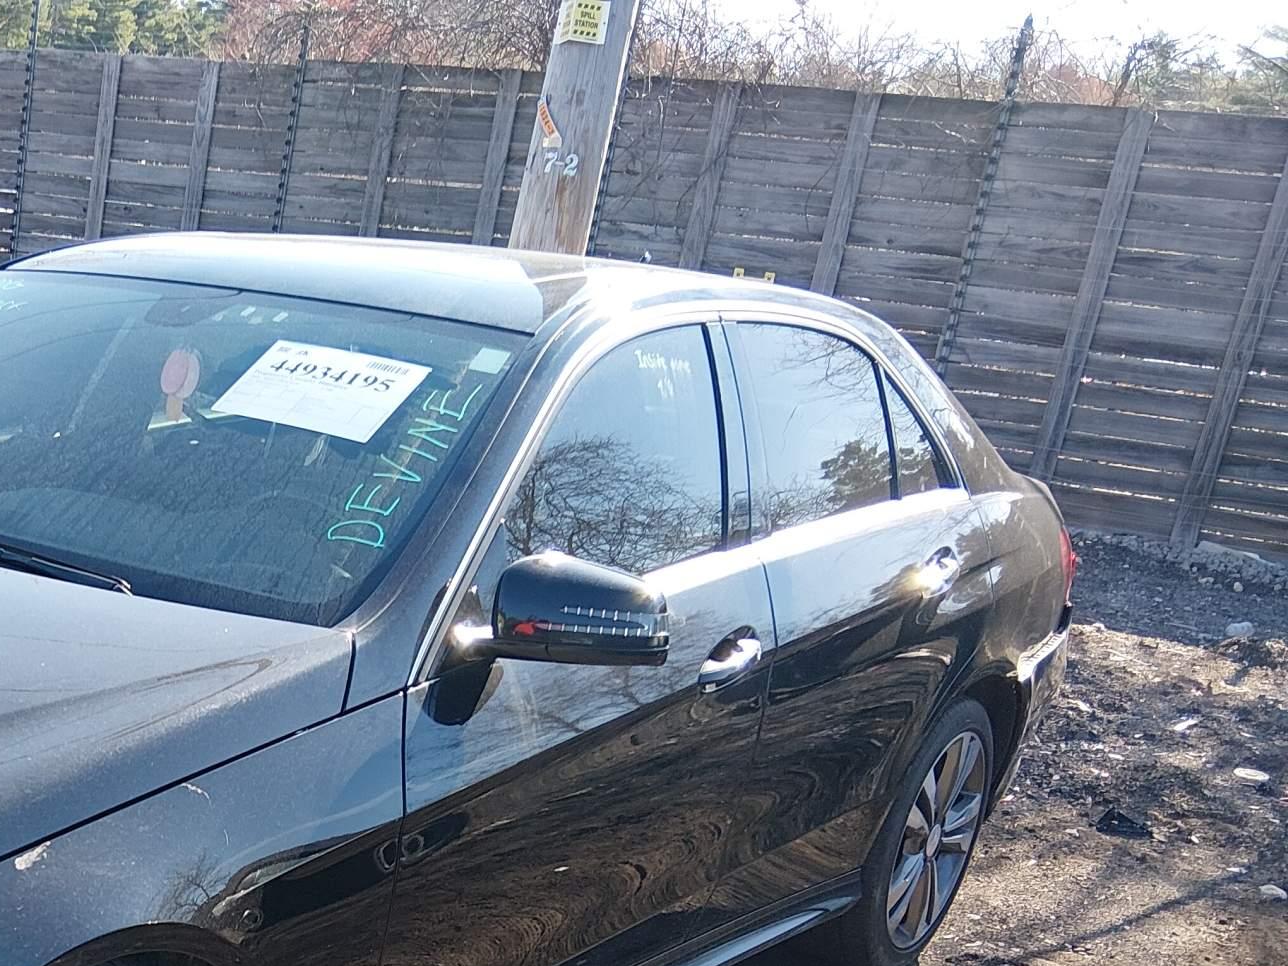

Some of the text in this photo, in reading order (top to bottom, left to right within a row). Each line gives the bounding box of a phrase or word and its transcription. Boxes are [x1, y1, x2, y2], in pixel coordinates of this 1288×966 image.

[574, 19, 599, 29] STATION
[580, 11, 596, 20] SPILL
[543, 151, 579, 177] 7-2
[270, 359, 397, 393] 44934195
[327, 383, 483, 549] DEVINE
